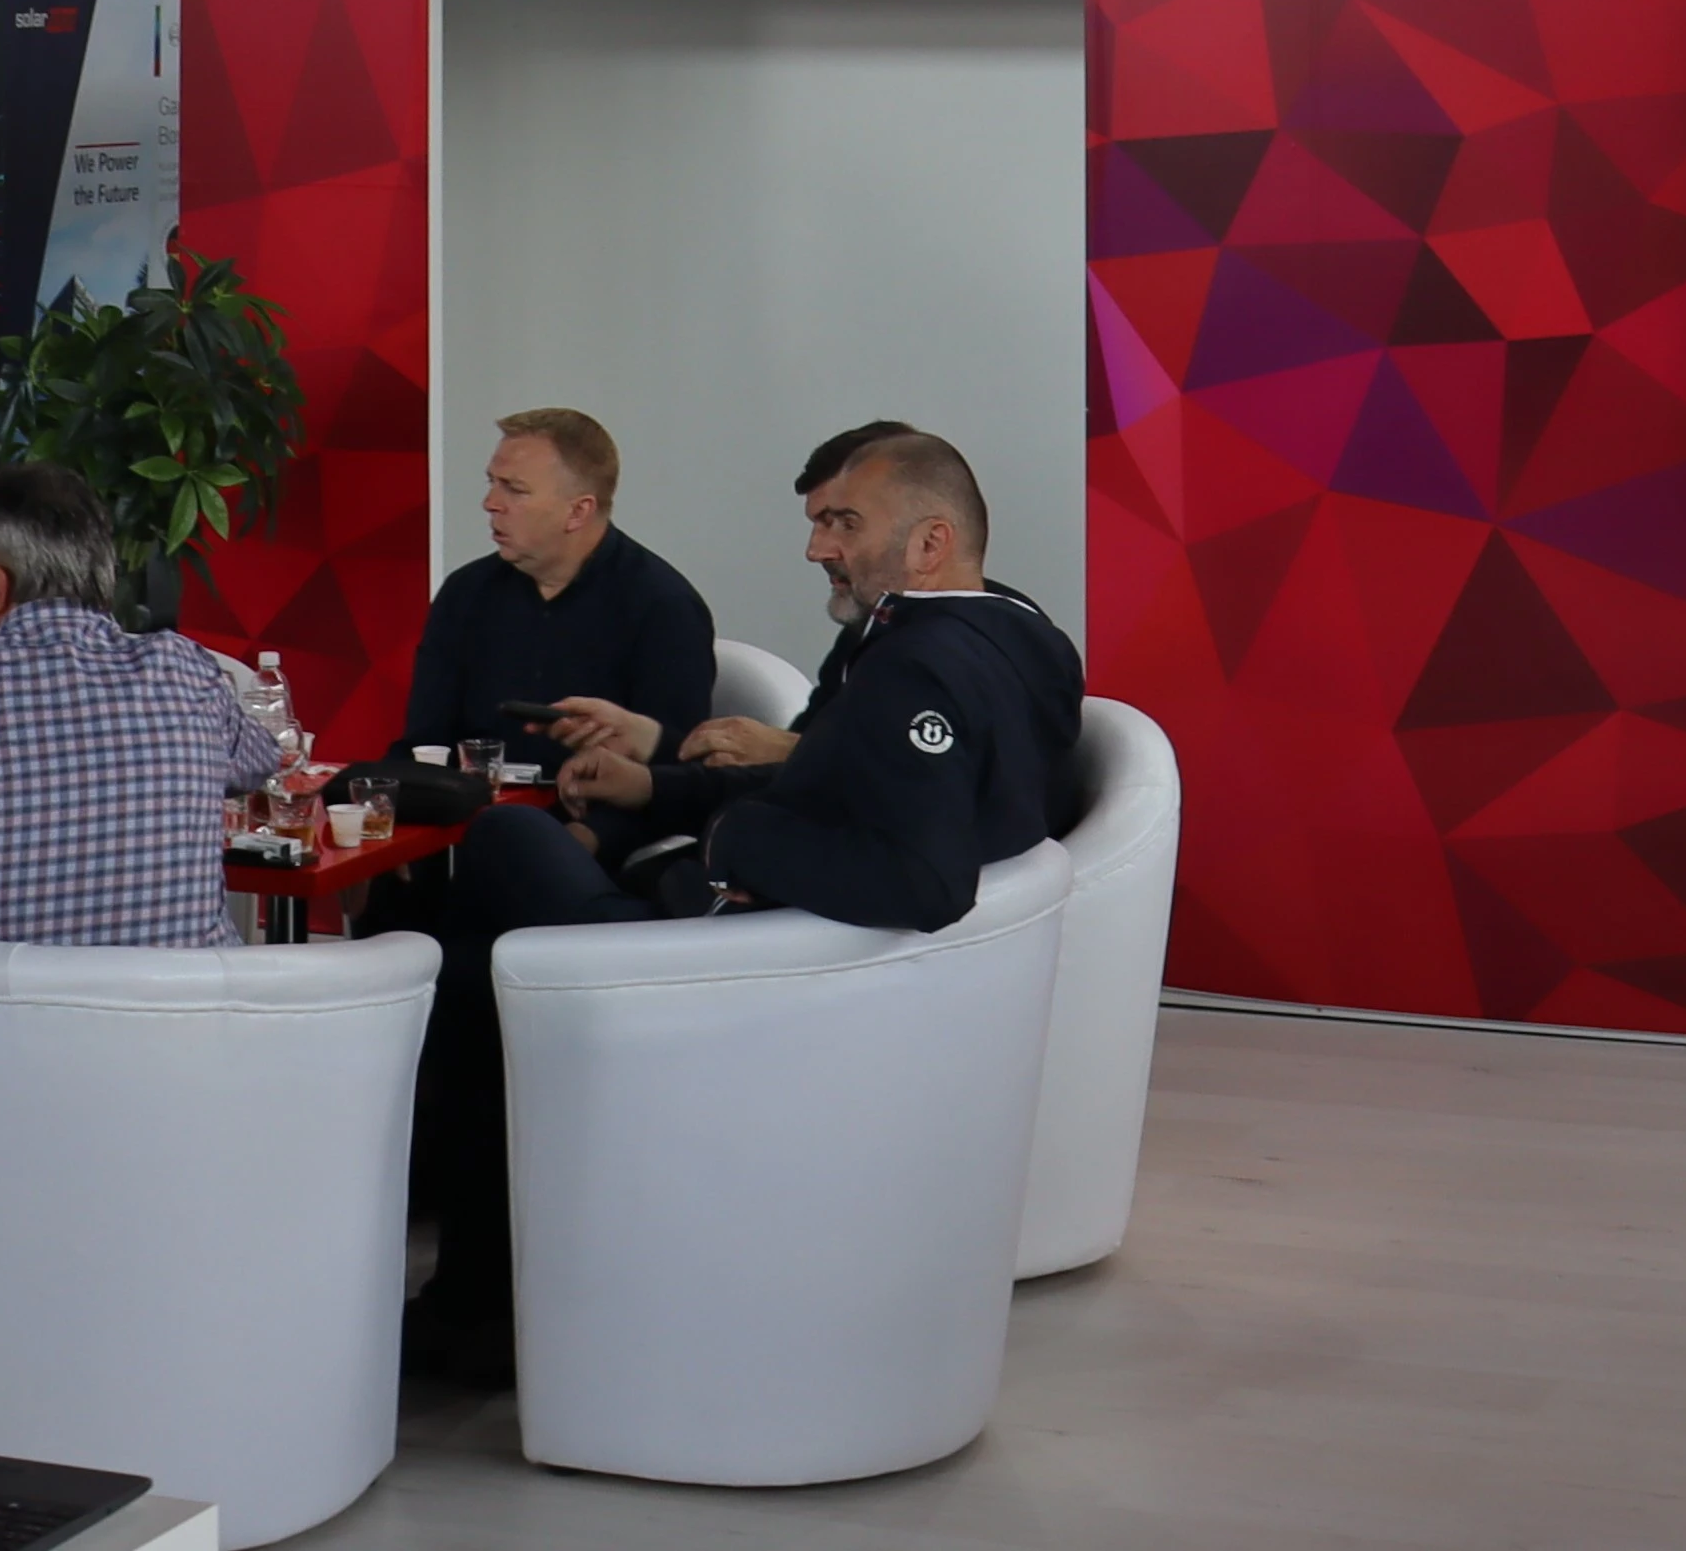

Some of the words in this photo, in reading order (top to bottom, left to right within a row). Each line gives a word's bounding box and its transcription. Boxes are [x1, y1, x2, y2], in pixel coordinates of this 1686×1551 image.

[73, 153, 95, 174] We
[97, 151, 140, 173] Power
[73, 185, 94, 206] the
[97, 184, 140, 204] Future
